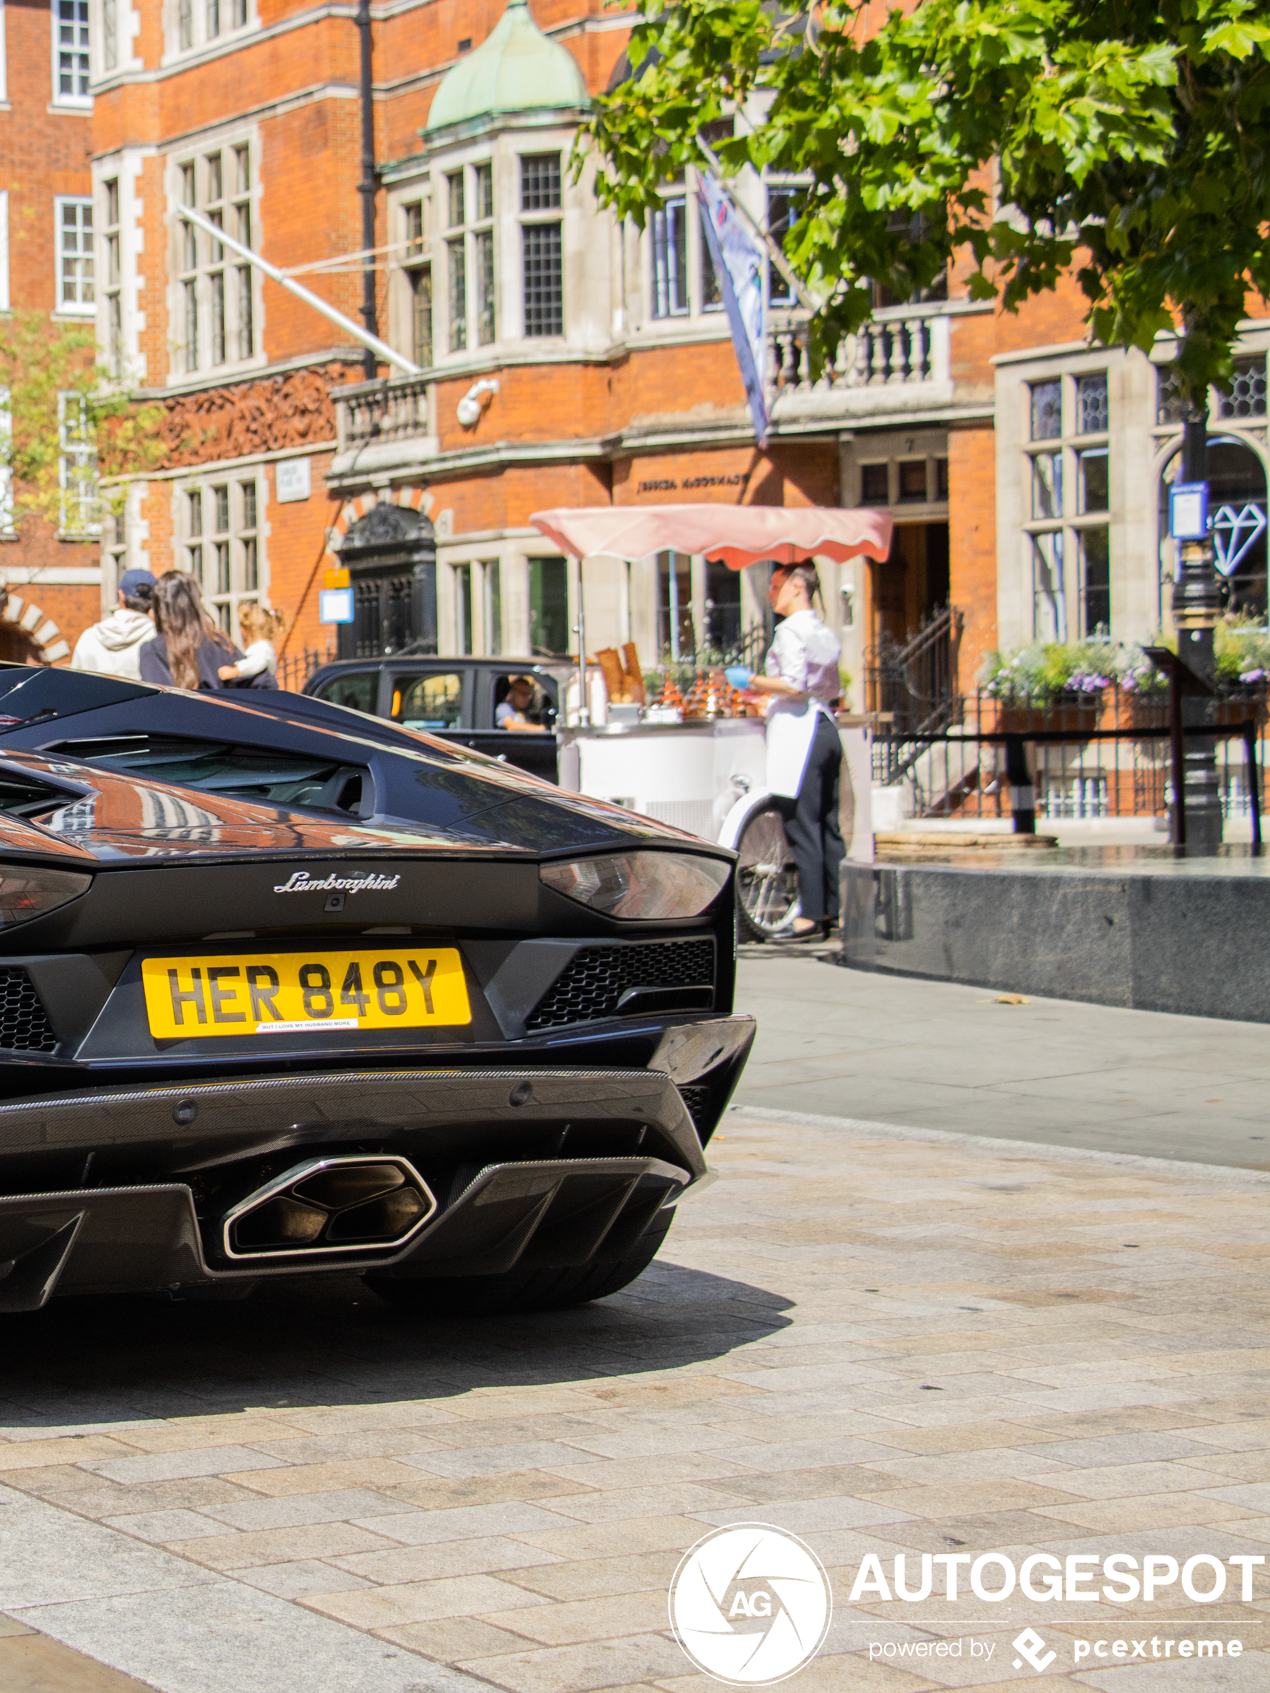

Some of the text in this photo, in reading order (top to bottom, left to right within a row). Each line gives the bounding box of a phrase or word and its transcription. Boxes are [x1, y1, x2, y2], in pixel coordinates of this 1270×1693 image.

[274, 871, 401, 893] Lamborghini
[167, 959, 437, 1025] HER 848Y
